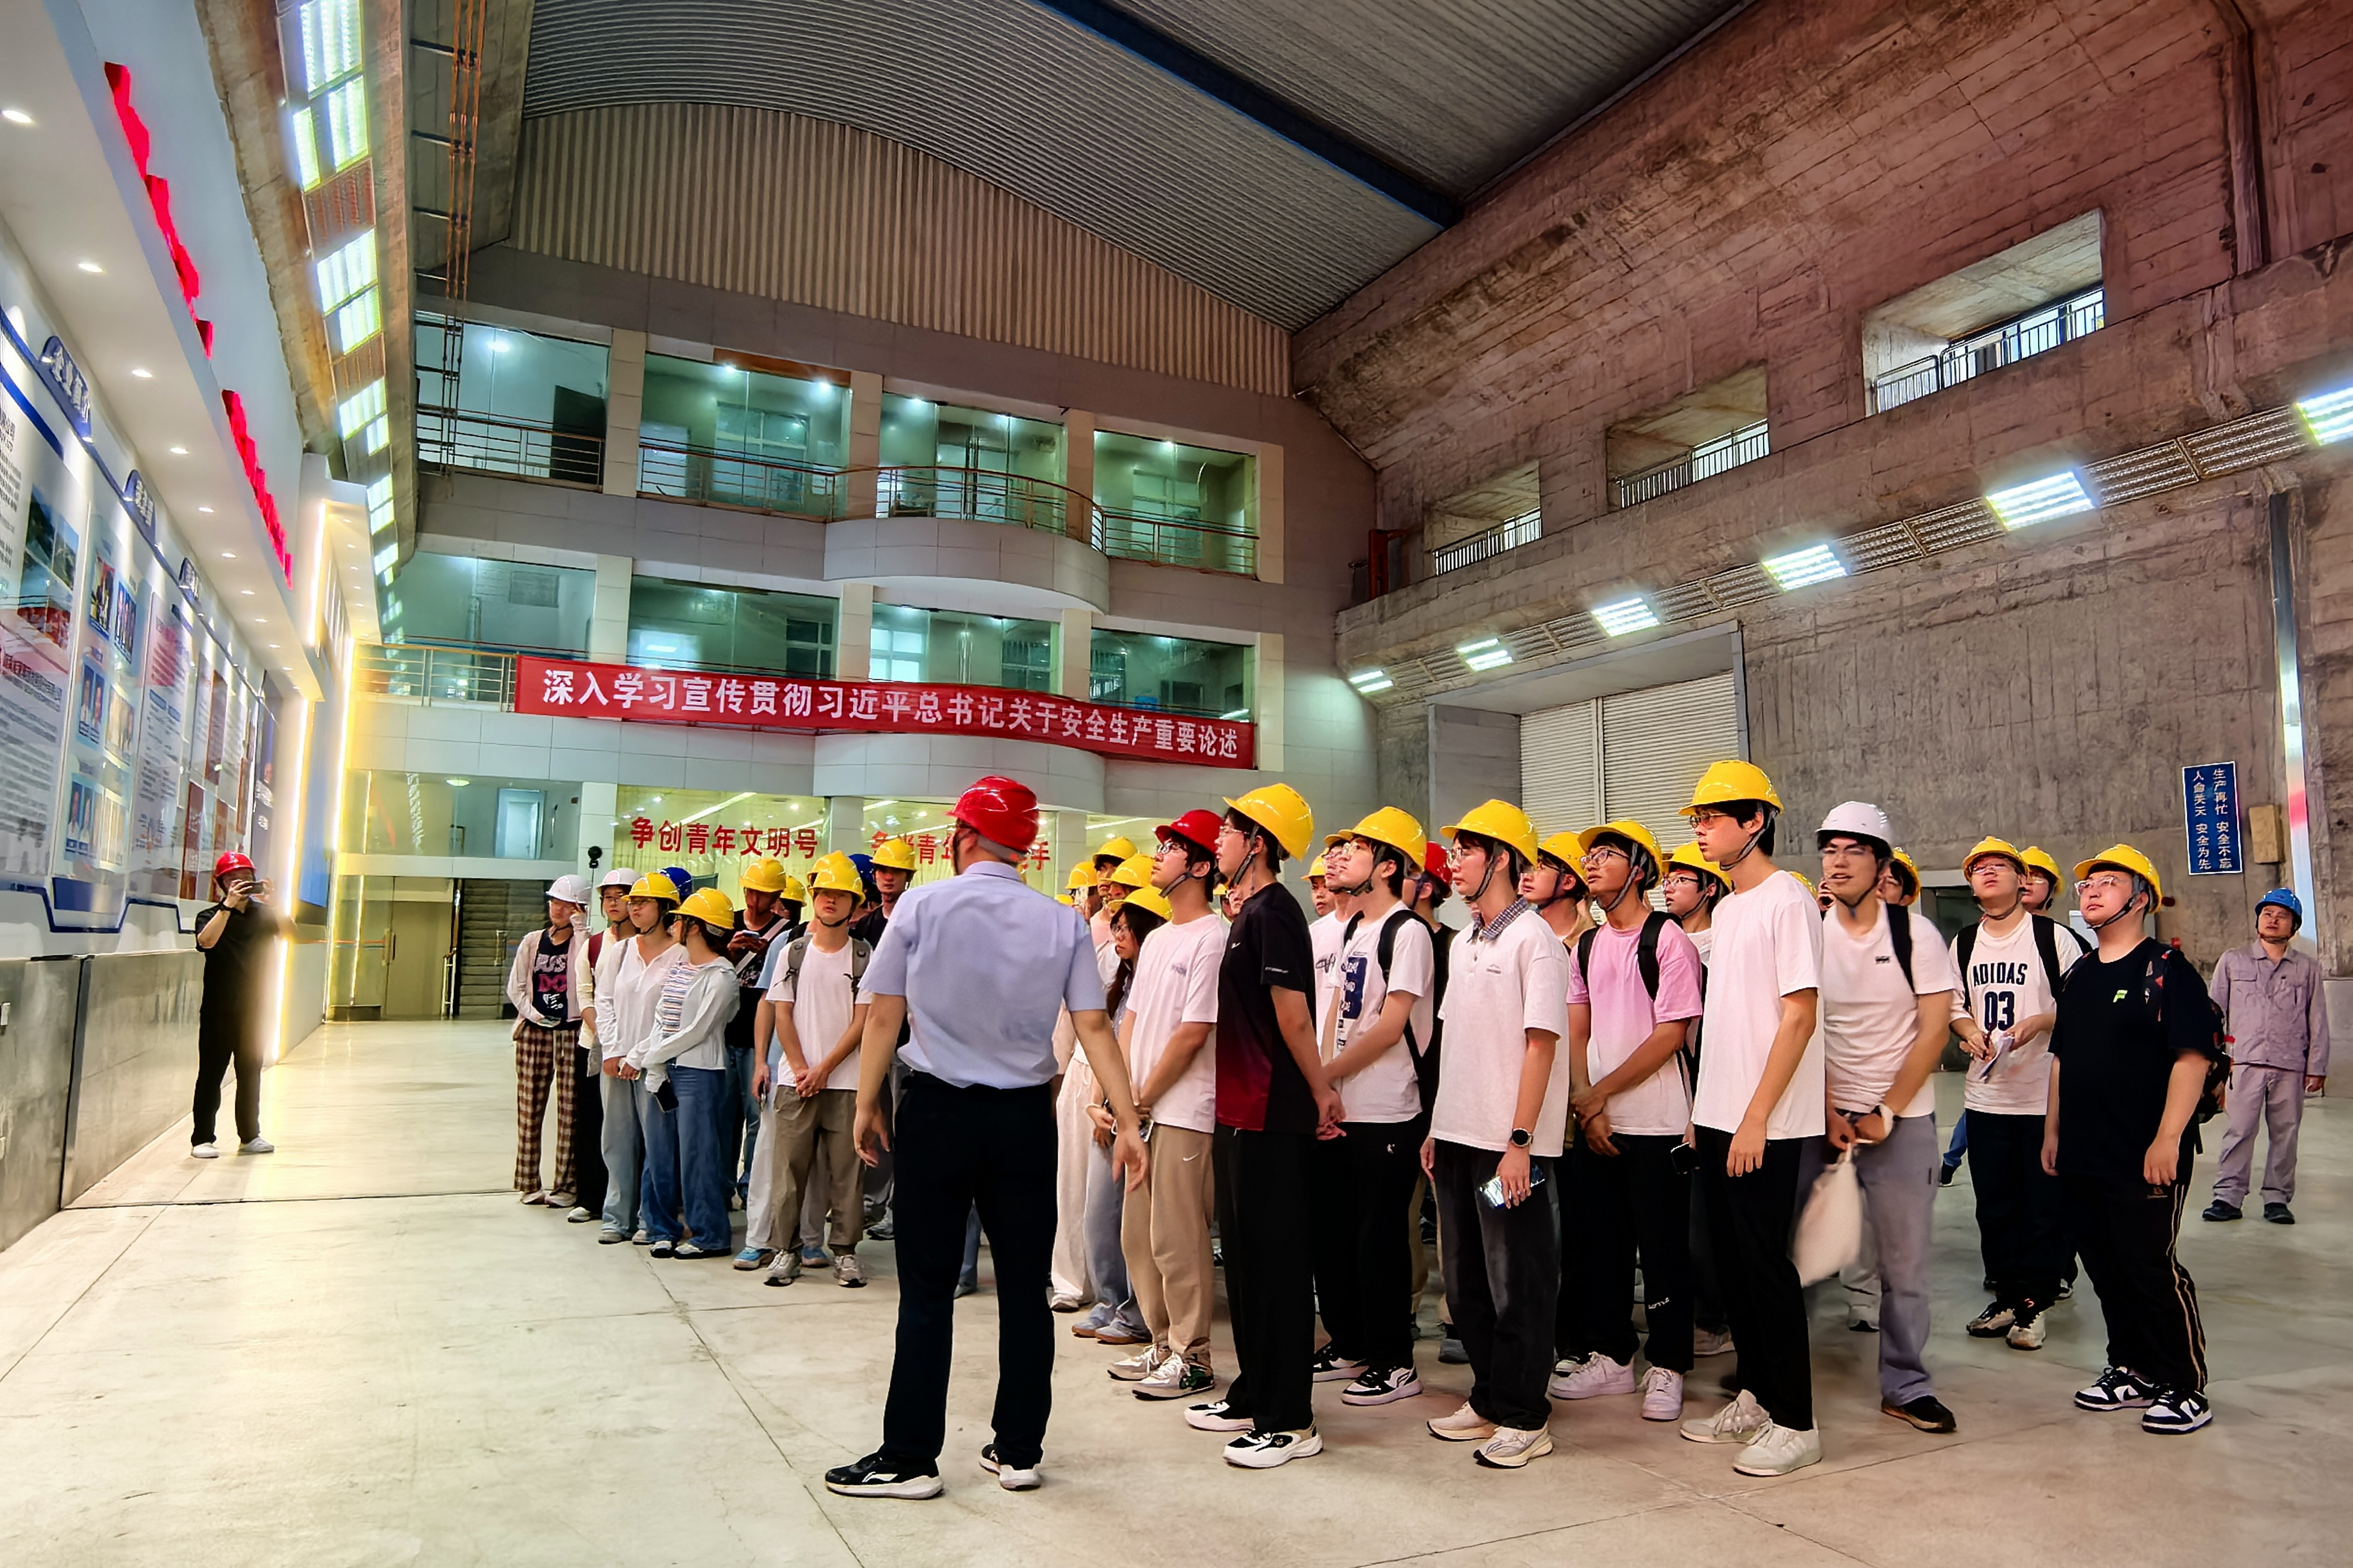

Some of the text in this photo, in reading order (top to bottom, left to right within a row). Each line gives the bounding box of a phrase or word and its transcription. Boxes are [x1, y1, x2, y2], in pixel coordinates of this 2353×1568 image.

[543, 669, 1238, 758] 深入学习宣传贯彻习近平总书记关于安全生产重要论述
[631, 816, 818, 858] 争创青年文明号
[1973, 962, 2027, 987] ADIDAS
[1984, 991, 2014, 1031] 03
